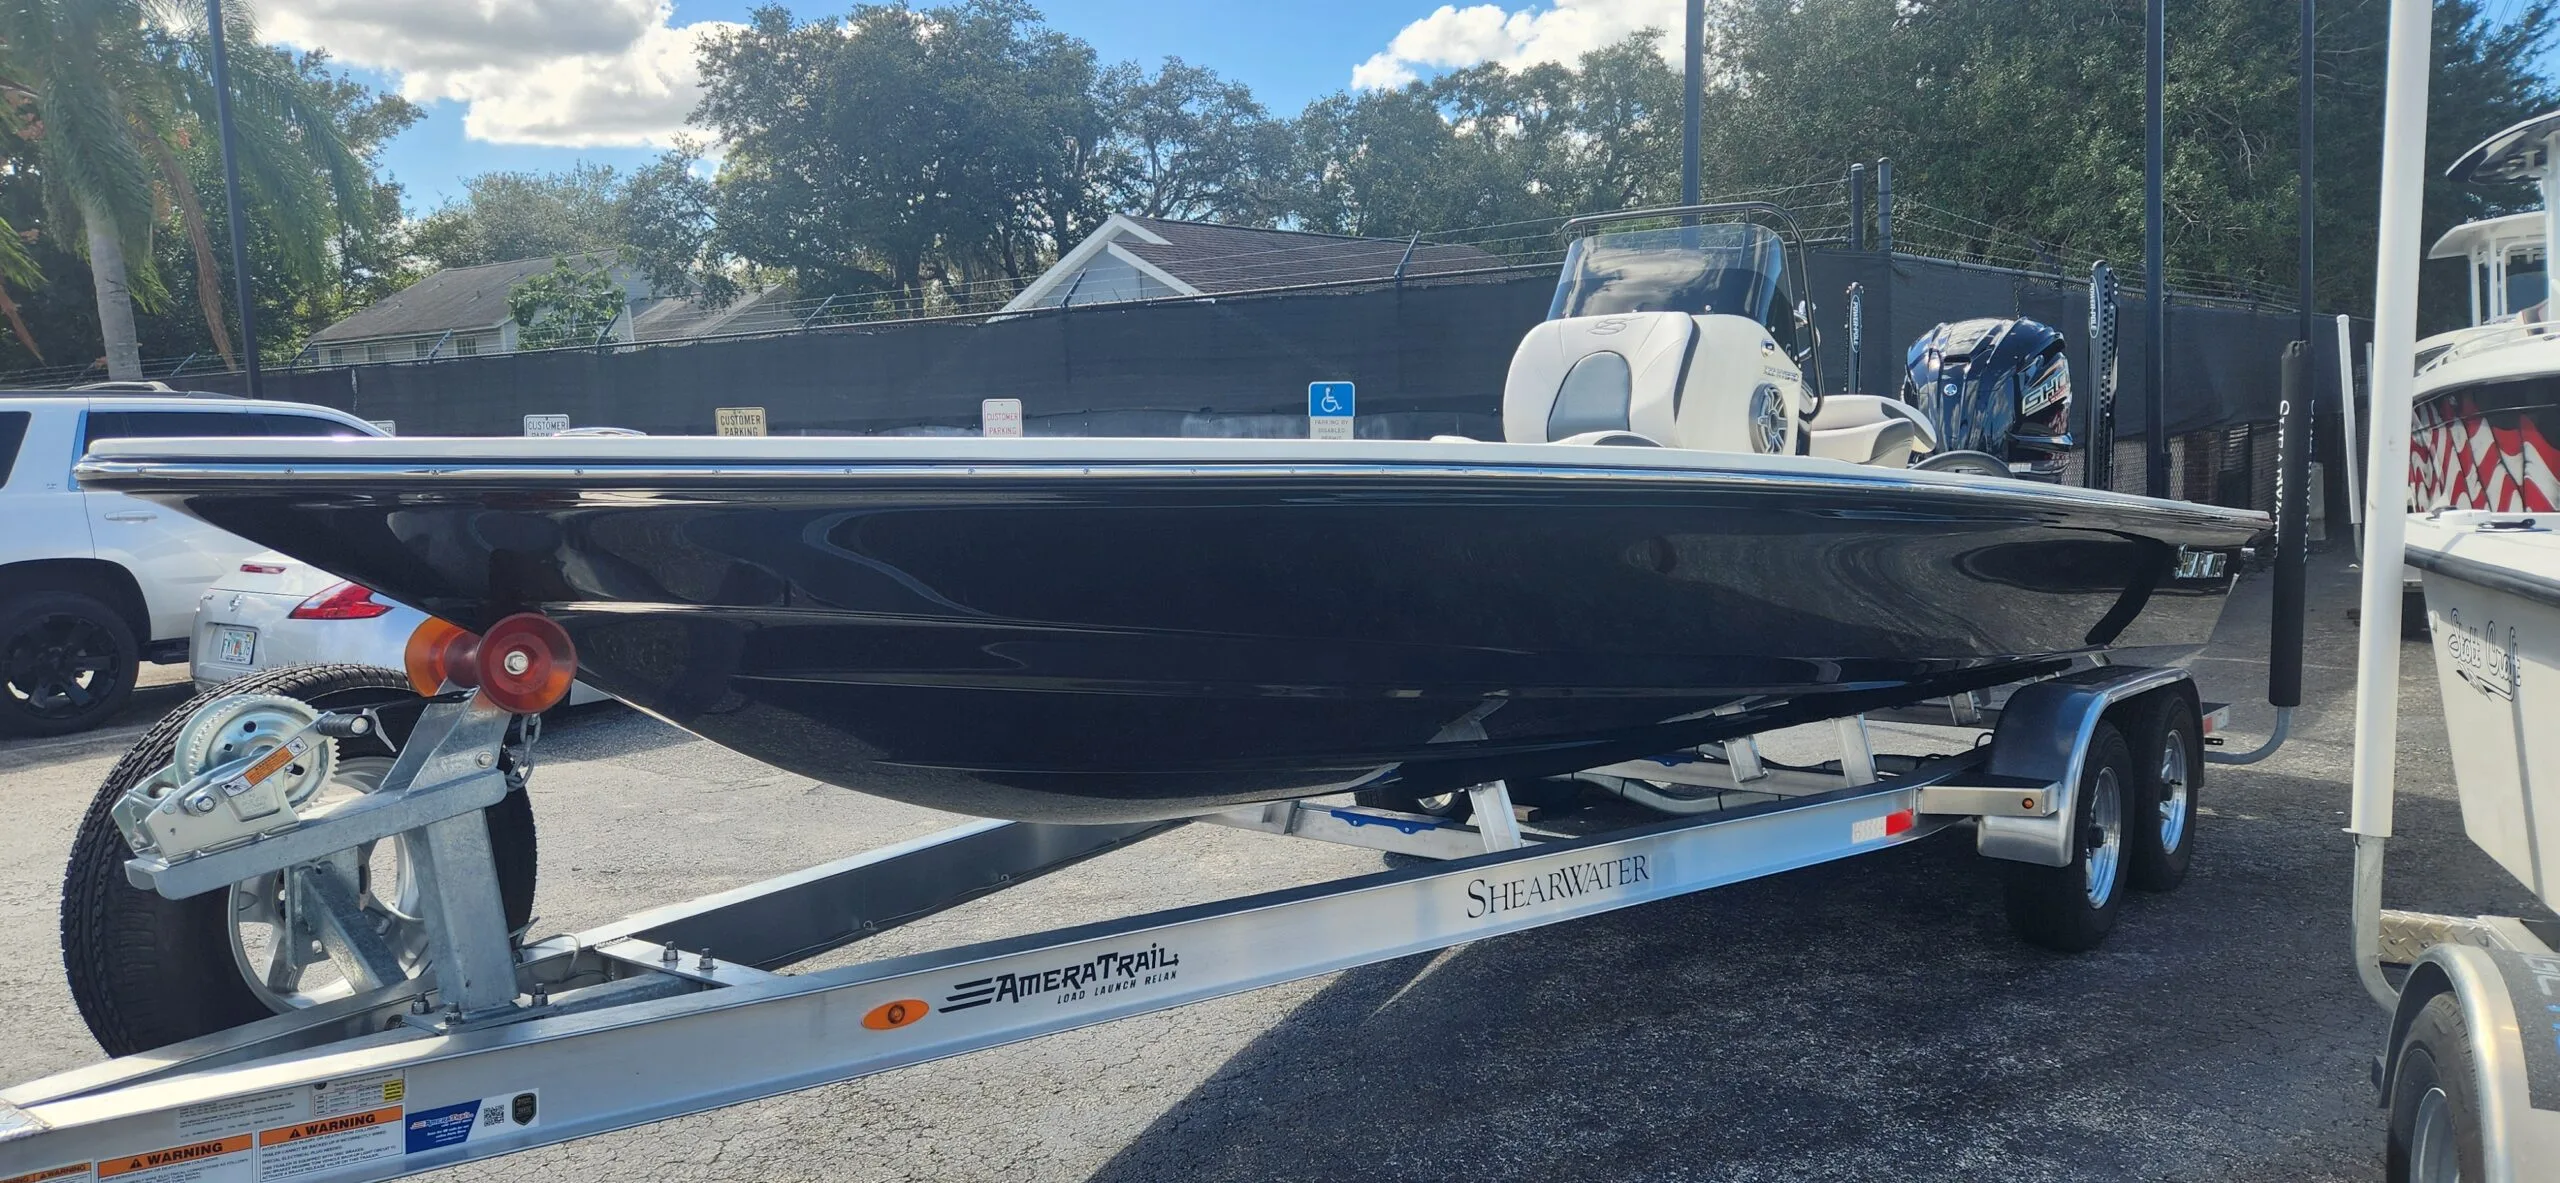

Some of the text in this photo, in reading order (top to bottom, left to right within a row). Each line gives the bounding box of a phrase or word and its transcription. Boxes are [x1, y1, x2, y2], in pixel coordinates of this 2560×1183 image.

[720, 414, 761, 426] CUSTOMER
[986, 412, 1018, 421] CUSTOMER
[528, 421, 566, 430] CUSTOMER
[724, 427, 758, 436] PARKING
[989, 426, 1017, 436] PARKING
[2486, 620, 2521, 695] Craft
[1466, 854, 1650, 919] SHEARWATER
[1056, 970, 1178, 1005] LOAD LAUNCH RELAX
[306, 1114, 376, 1136] WARNING
[147, 1142, 223, 1166] WARNING
